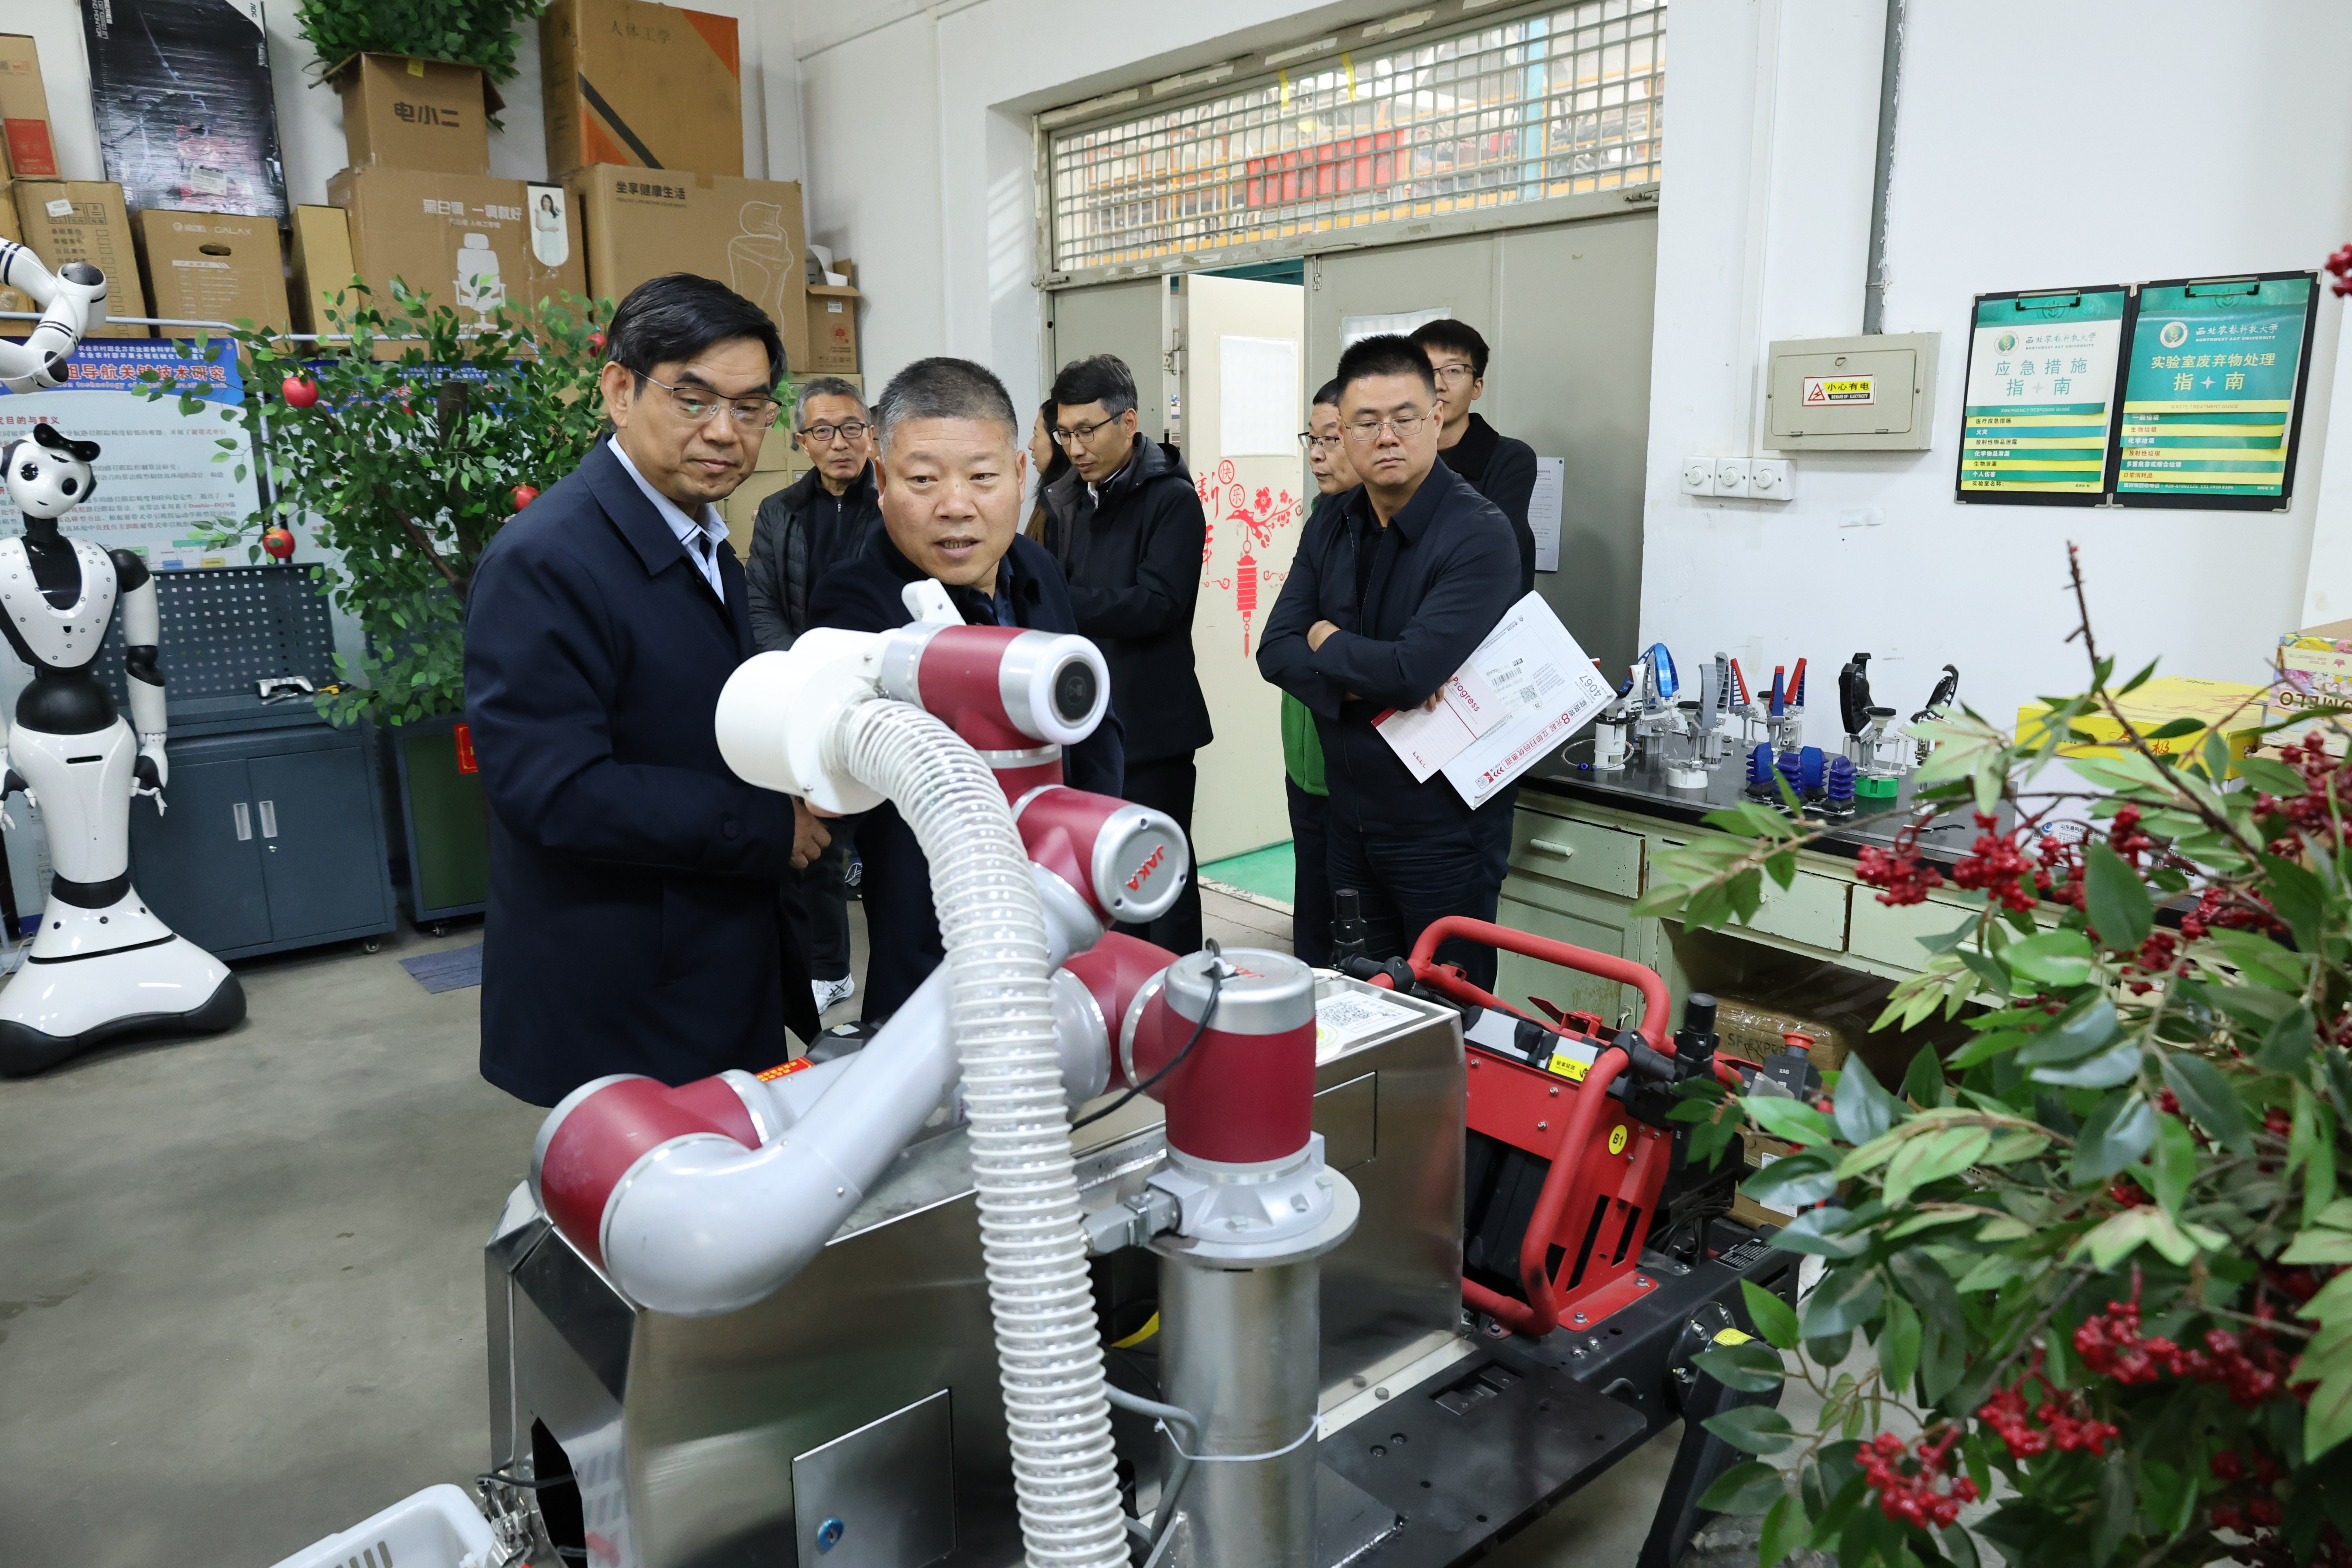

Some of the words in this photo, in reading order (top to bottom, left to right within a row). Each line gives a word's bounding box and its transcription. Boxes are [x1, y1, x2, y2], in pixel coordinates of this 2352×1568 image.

[611, 20, 671, 44] 人体工学
[394, 102, 460, 127] 电小二
[616, 181, 685, 200] 坐享健康生活
[423, 199, 464, 216] 黑白调
[2025, 331, 2096, 344] 西北农林科技大学
[2195, 323, 2279, 336] 西北农林科技大学
[1995, 357, 2087, 376] 应急措施
[2151, 352, 2276, 369] 实验室废弃物处理
[1827, 382, 1869, 391] 小心有电
[1453, 677, 1480, 711] Progress
[1579, 675, 1601, 696] 4067
[1549, 699, 1589, 733] 购退货8元起
[1504, 729, 1550, 766] 立即扫码优惠退
[1125, 844, 1164, 891] JAKA
[1728, 1033, 1743, 1047] SF
[1748, 1039, 1786, 1056] EXPRE
[1556, 1060, 1575, 1071] 轻拿轻放
[1612, 1133, 1624, 1146] B1
